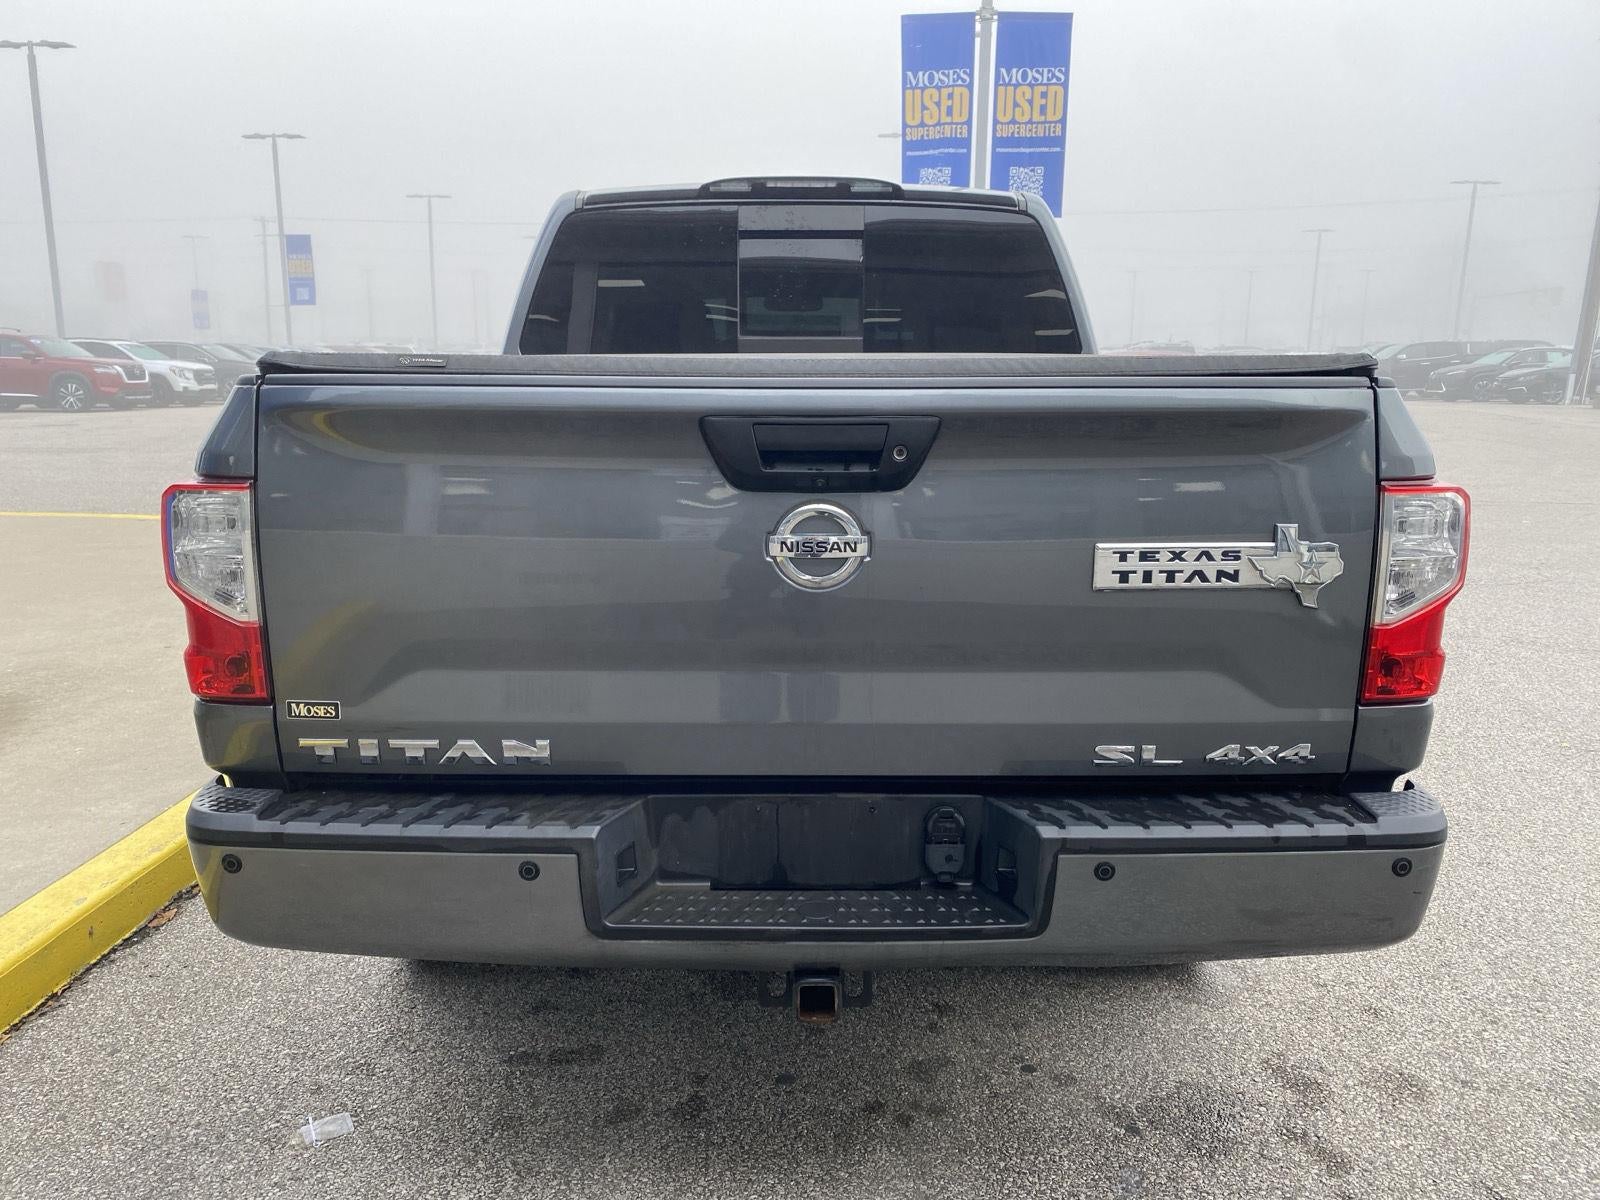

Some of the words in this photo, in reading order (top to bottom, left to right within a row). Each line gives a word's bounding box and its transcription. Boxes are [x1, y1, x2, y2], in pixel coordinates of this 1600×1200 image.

[905, 68, 970, 88] MOSES
[998, 67, 1065, 85] MOSES
[905, 86, 970, 126] USED
[996, 84, 1065, 123] USED
[905, 124, 969, 142] SUPERCENTER
[996, 123, 1062, 138] SUPERCENTER
[780, 540, 858, 553] NISSAN
[1112, 550, 1243, 563] TEXAS
[1112, 569, 1240, 584] TITAN
[291, 703, 336, 718] MOSES
[298, 738, 552, 765] TITAN
[1093, 744, 1184, 766] SL
